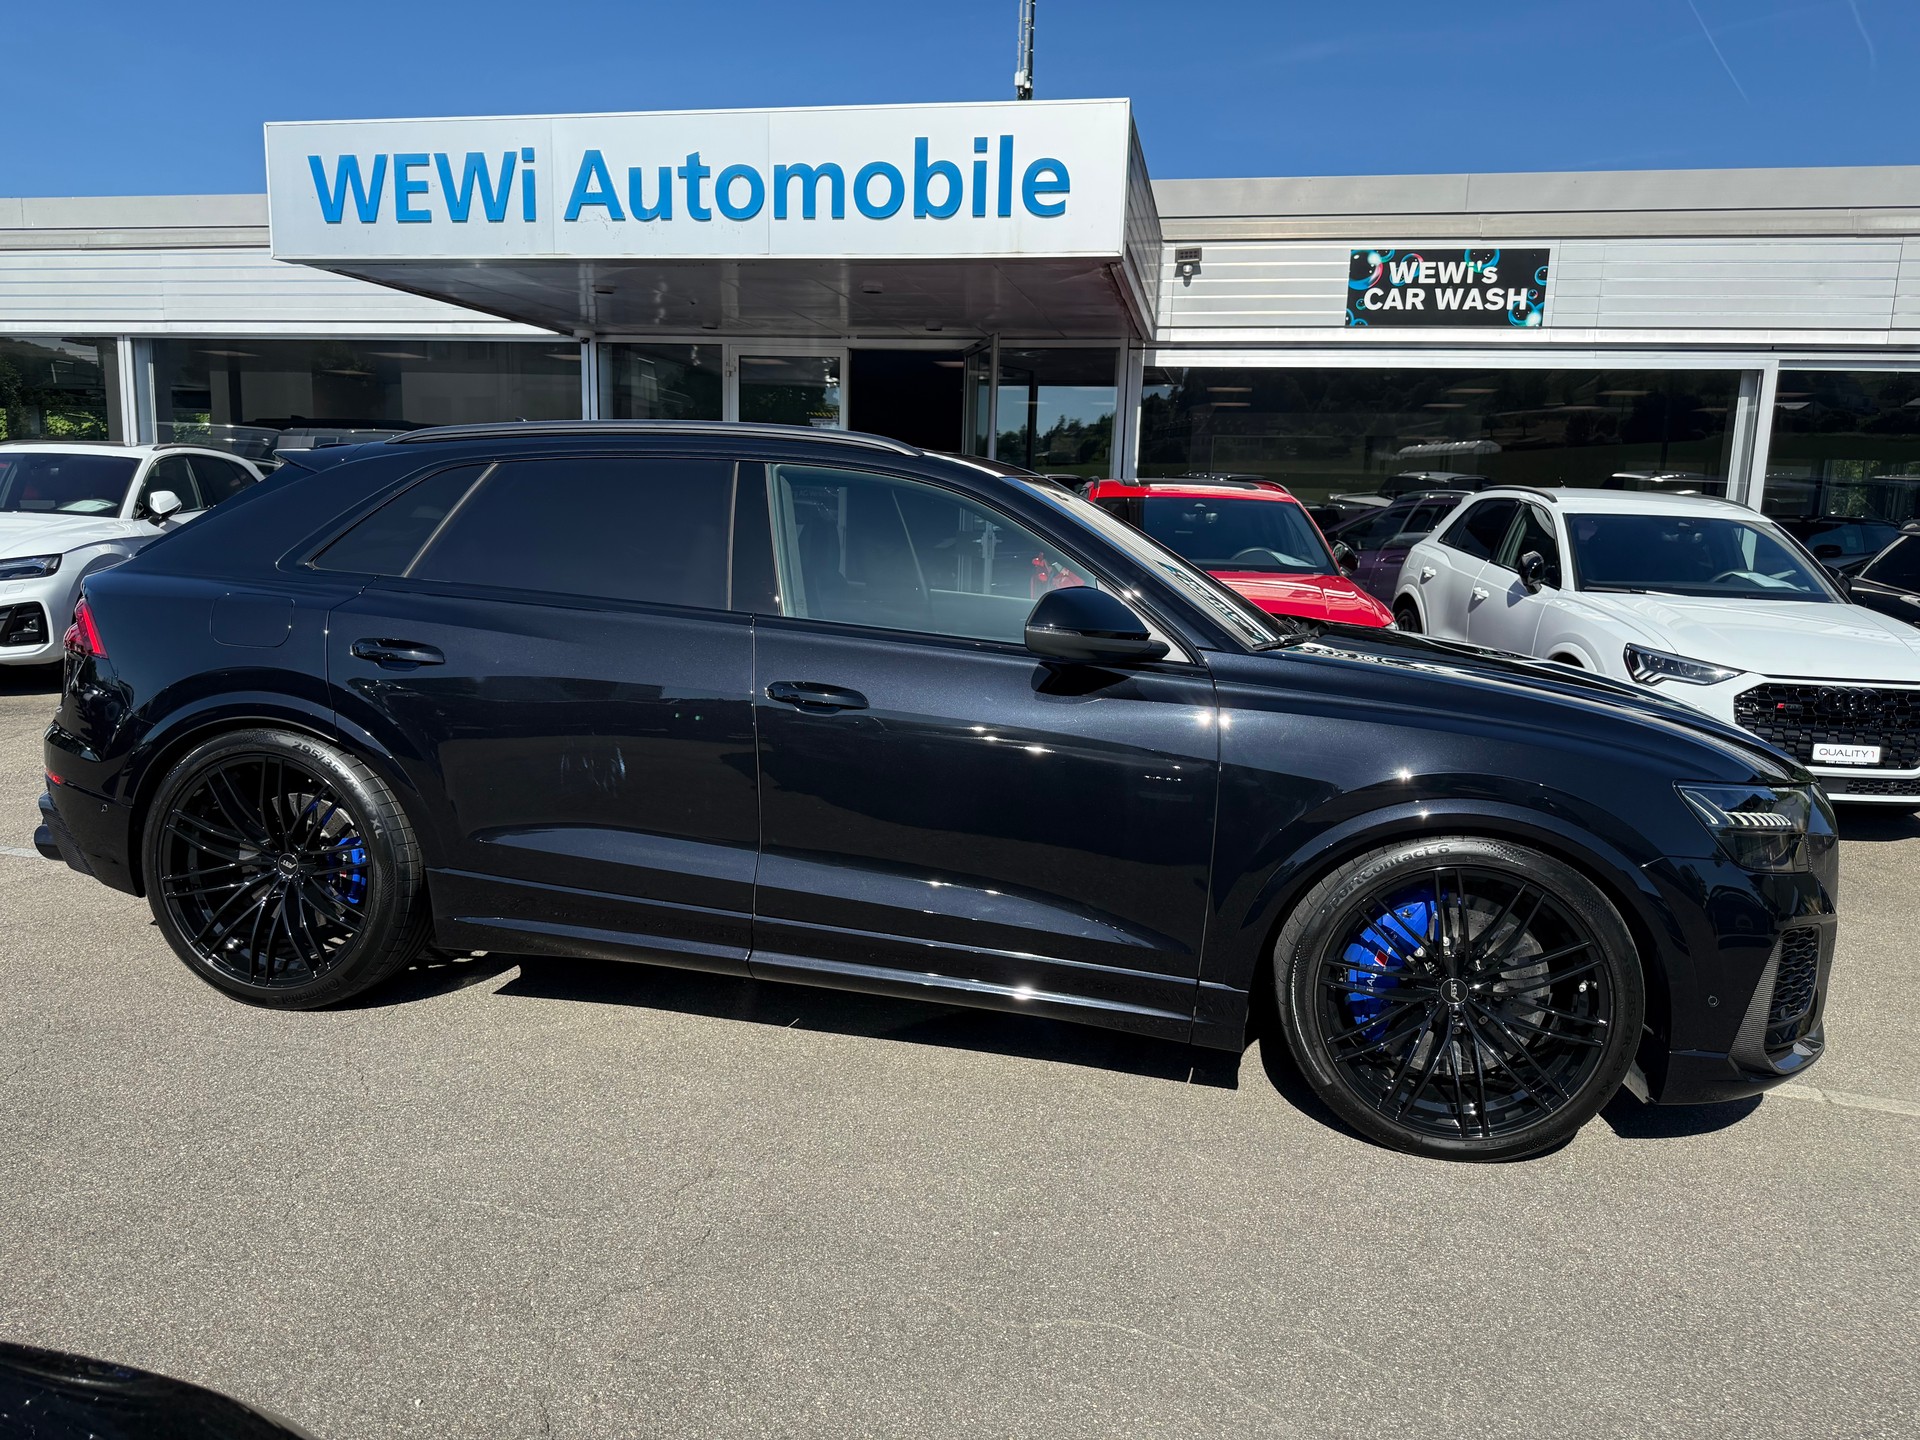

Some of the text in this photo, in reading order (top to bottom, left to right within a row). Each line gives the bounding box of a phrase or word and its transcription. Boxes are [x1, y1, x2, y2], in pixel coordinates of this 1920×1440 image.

[308, 136, 1070, 222] WEWi Automobile
[1388, 260, 1498, 284] WEWi's
[1363, 287, 1528, 311] CAR WASH
[1819, 748, 1869, 758] QUALITY
[291, 740, 342, 774] 295/35
[369, 817, 384, 839] XL
[1437, 843, 1451, 854] 6
